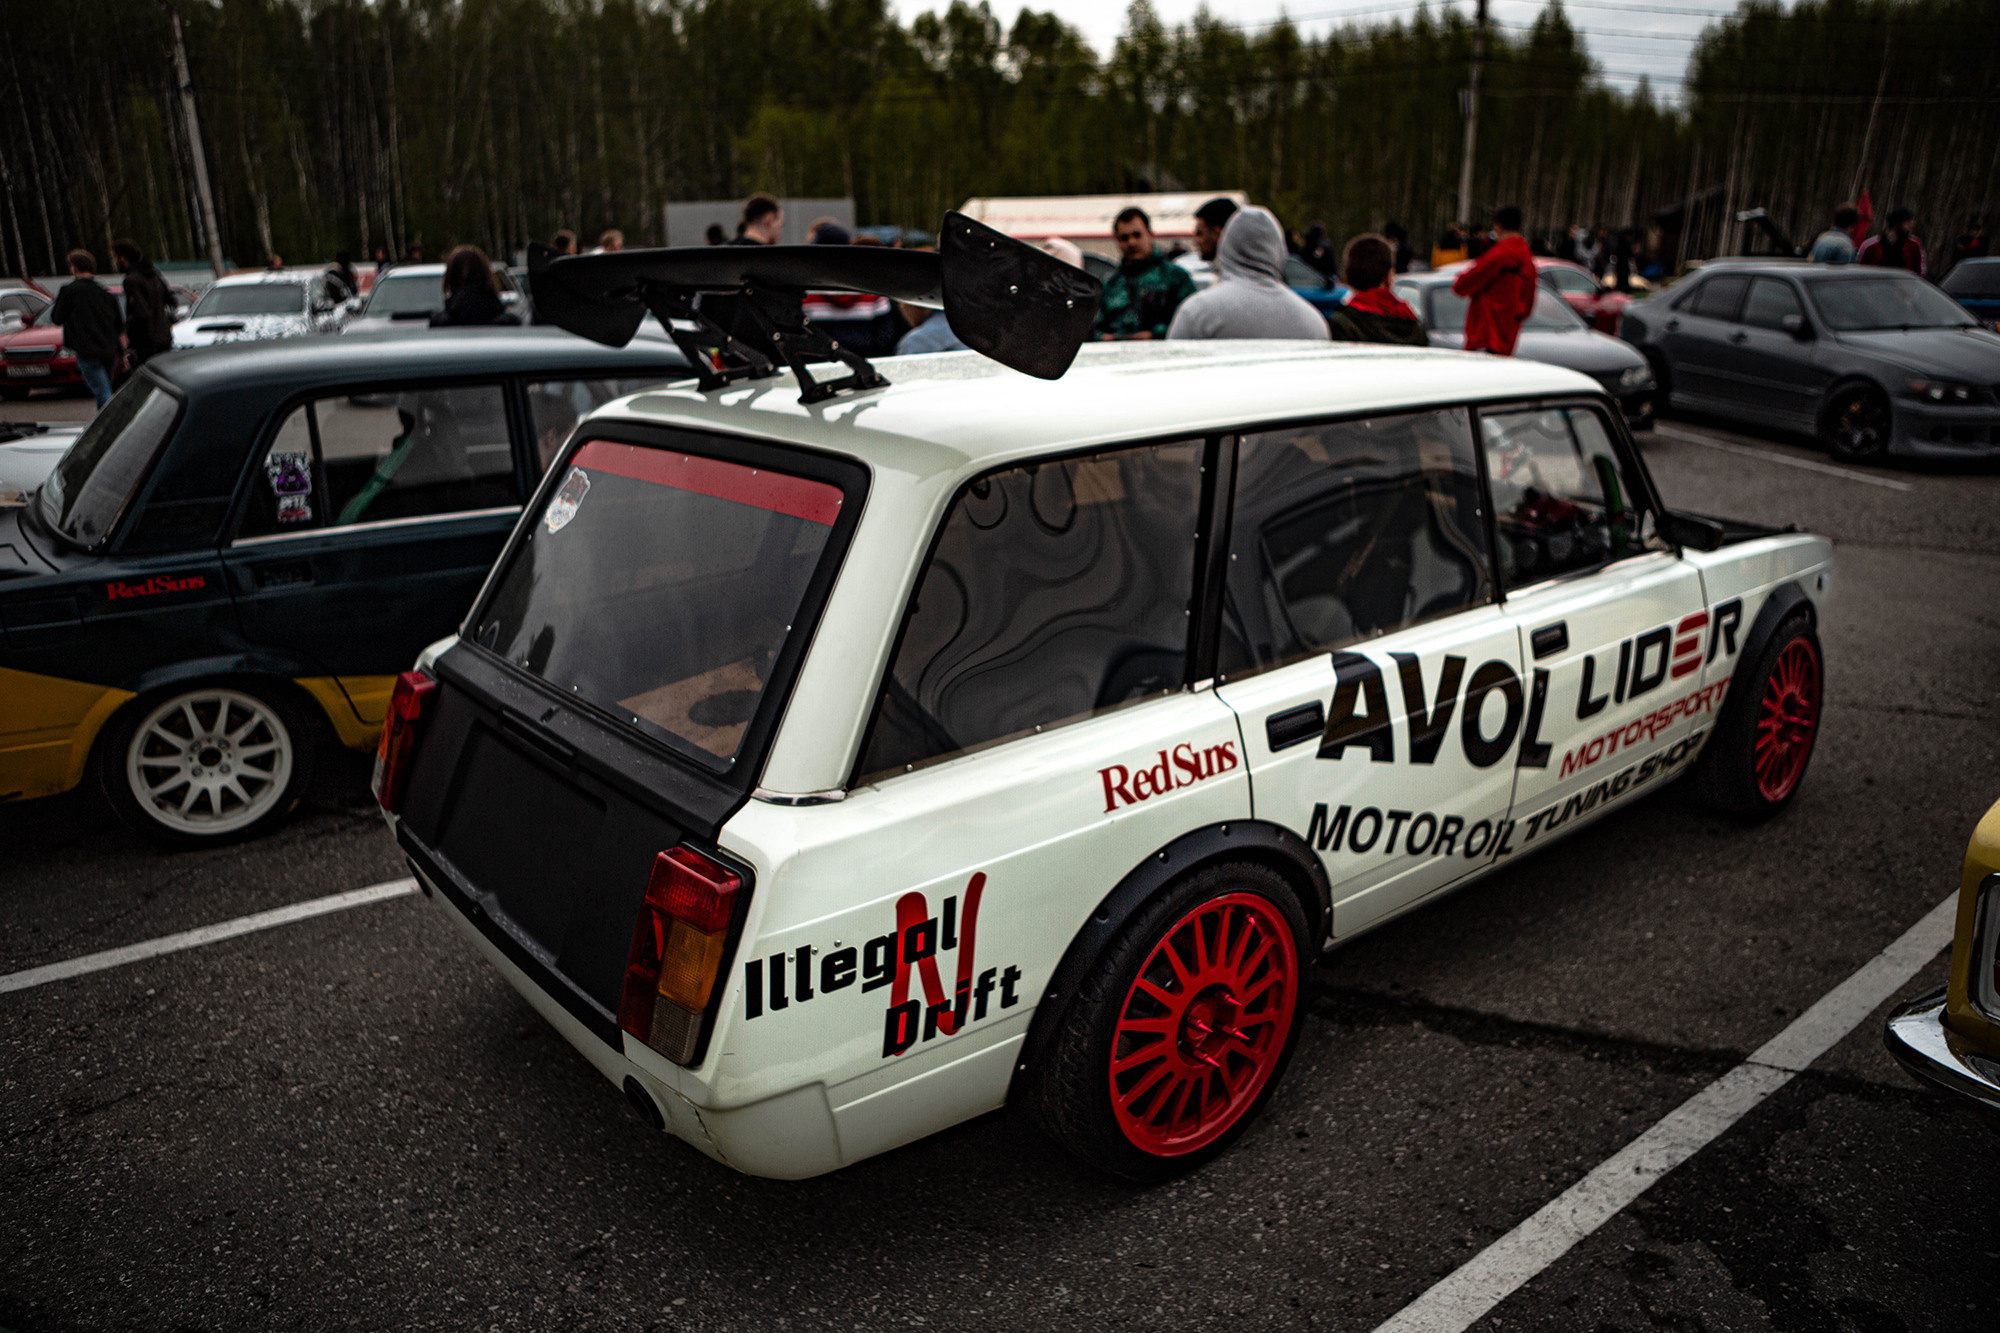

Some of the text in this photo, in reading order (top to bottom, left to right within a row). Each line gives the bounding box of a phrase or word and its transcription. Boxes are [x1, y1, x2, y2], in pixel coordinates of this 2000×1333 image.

[106, 575, 205, 600] RedSuns
[1315, 651, 1553, 769] AVOL
[1576, 597, 1743, 720] LIDER
[1097, 741, 1238, 813] RedSuns
[1558, 677, 1731, 780] MOTORSPORT
[1306, 802, 1516, 859] MOTOR OIL
[1524, 730, 1704, 842] TUNING SHOP
[745, 895, 958, 1021] Illegal
[882, 964, 1022, 1059] Drift
